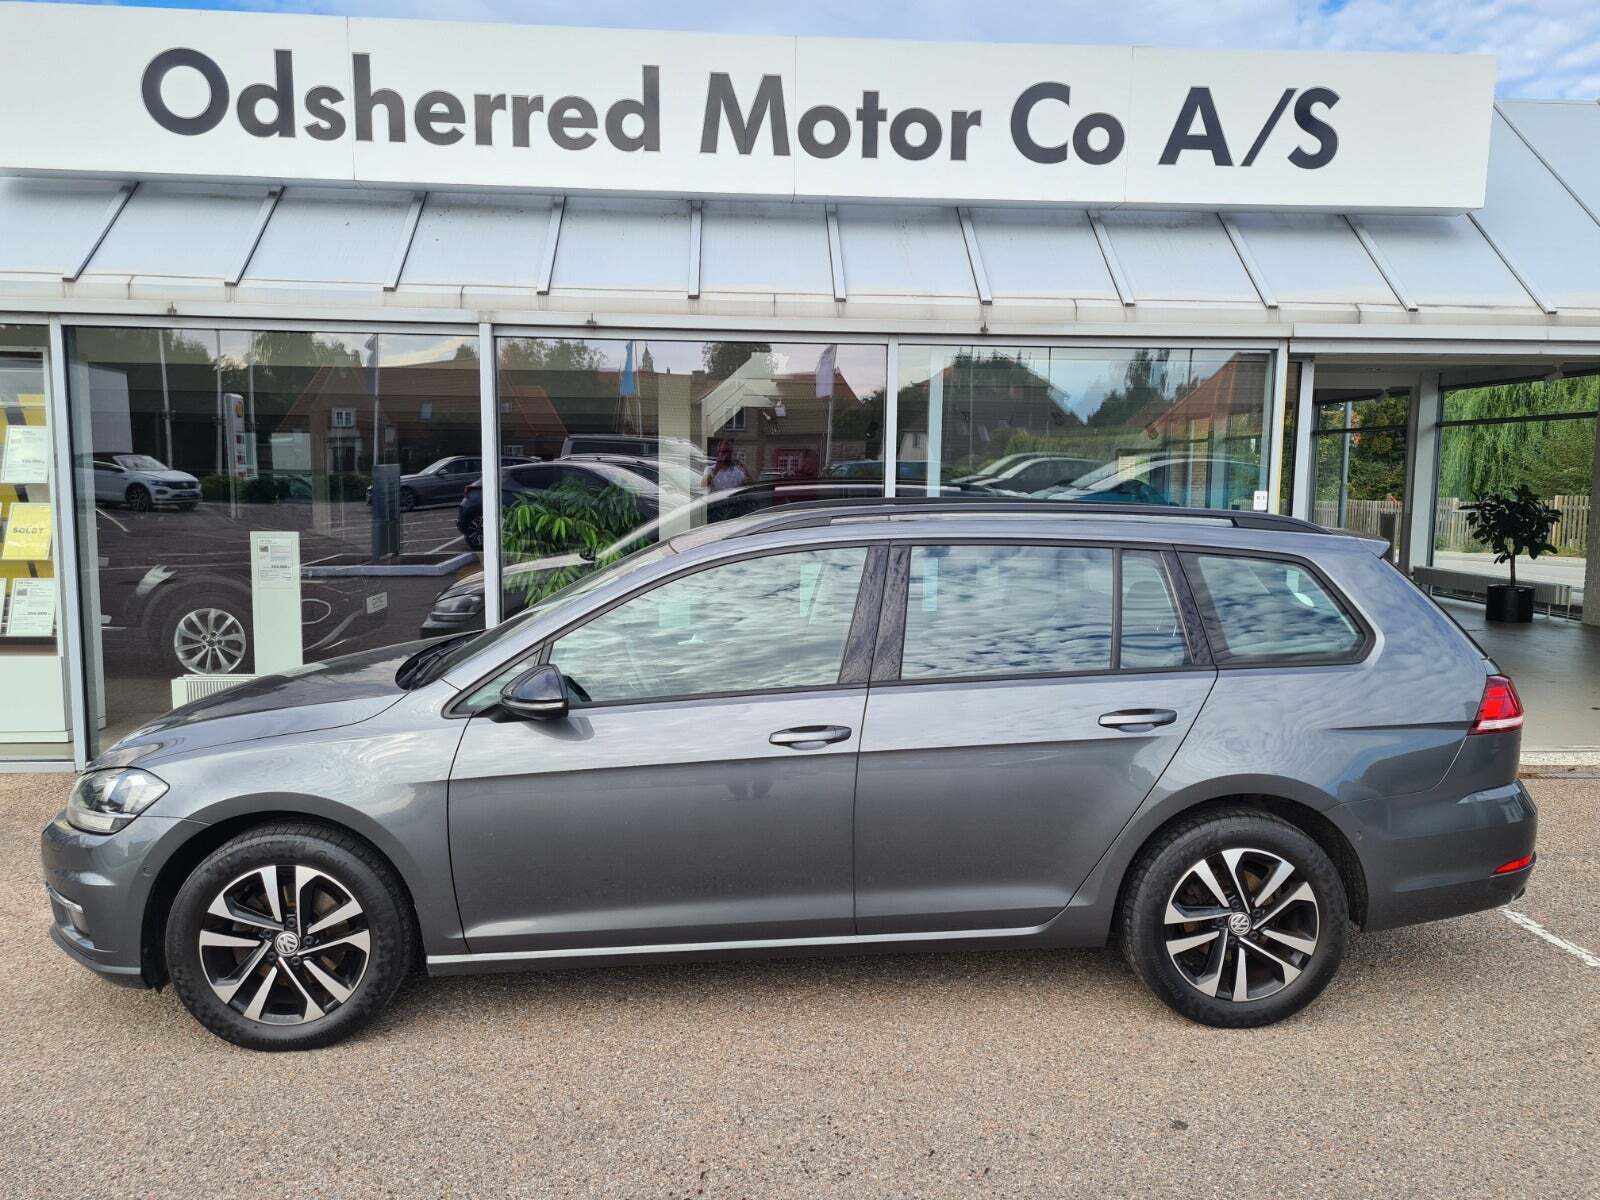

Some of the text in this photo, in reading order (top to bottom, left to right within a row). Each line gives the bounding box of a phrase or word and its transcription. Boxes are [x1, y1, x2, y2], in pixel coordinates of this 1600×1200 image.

[141, 47, 1341, 170] Odsherred Motor Co A/S
